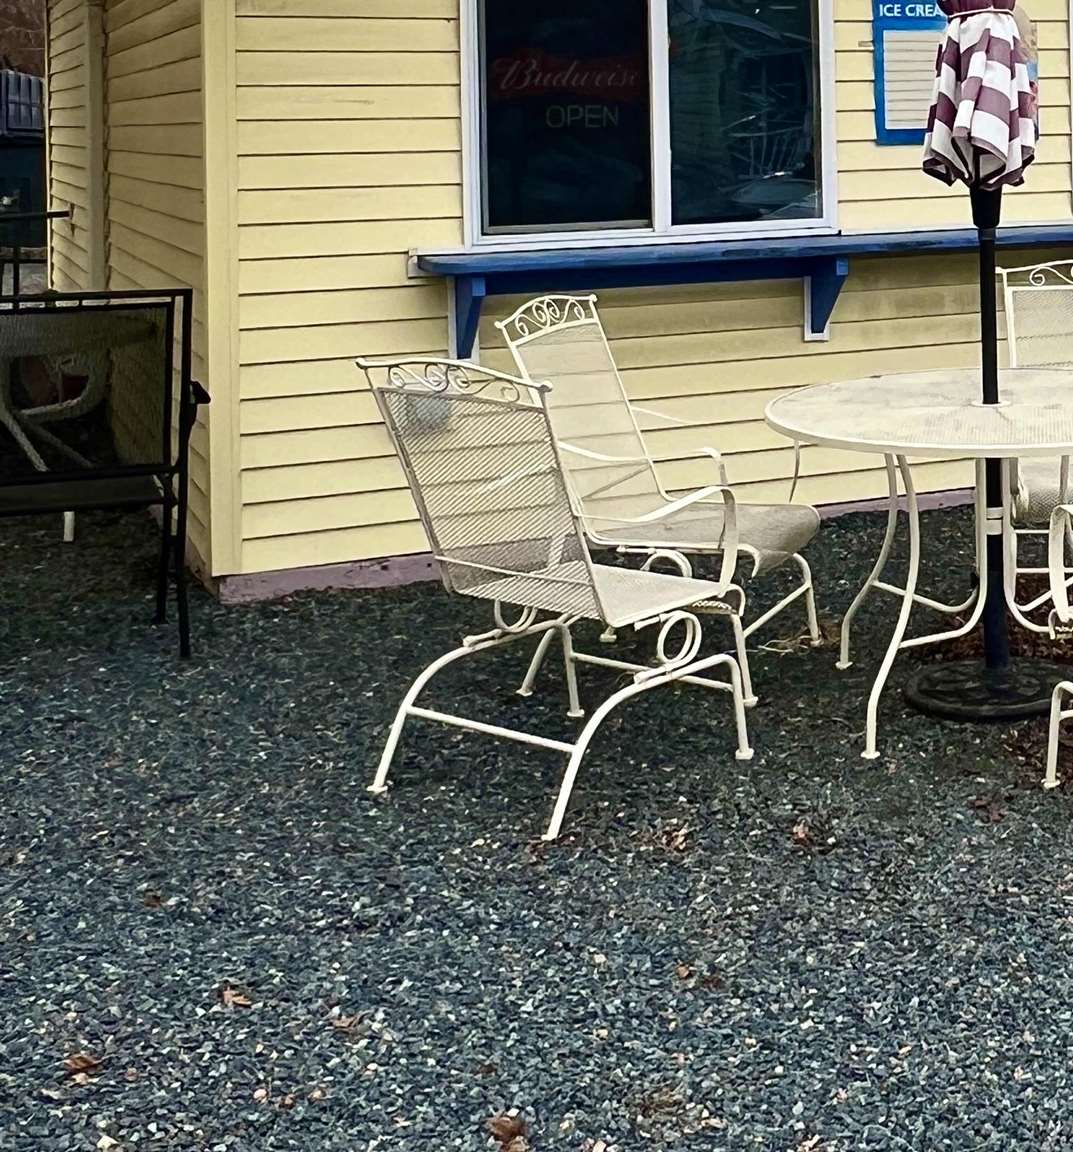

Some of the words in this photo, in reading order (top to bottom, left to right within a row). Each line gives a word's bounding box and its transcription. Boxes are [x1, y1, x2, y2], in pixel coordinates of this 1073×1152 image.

[879, 4, 901, 17] ICE
[905, 4, 944, 17] CREA
[545, 104, 619, 129] OPEN
